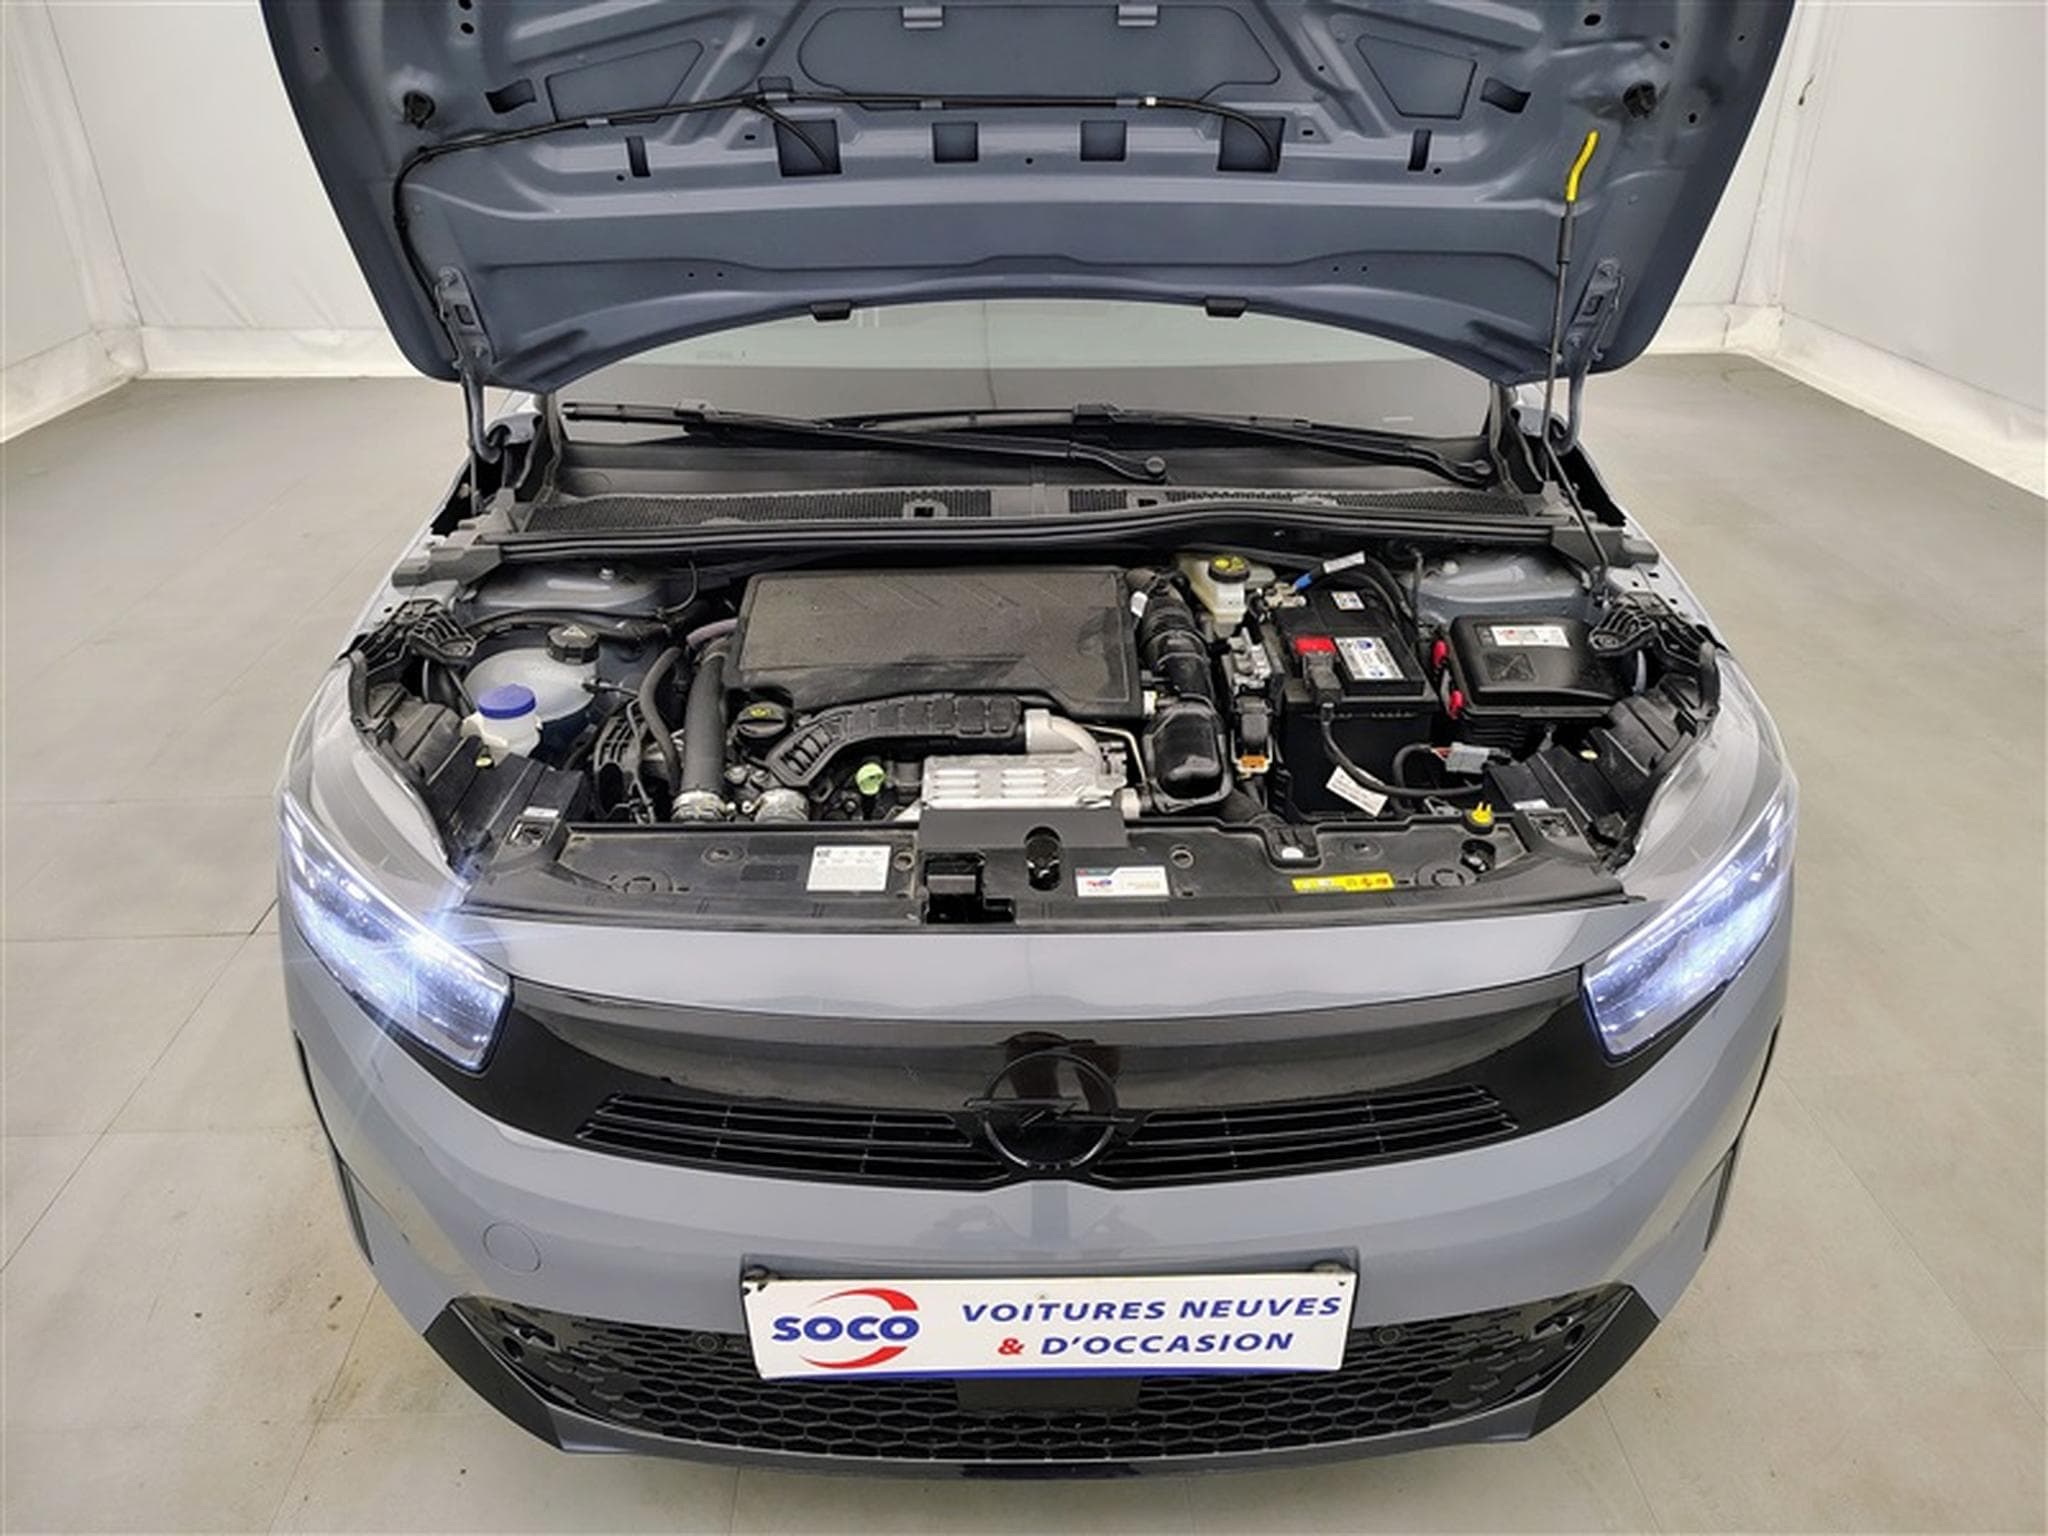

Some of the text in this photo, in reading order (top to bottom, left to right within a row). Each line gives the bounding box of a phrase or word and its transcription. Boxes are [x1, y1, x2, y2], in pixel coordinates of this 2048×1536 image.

[962, 1297, 1342, 1322] VOITURES NEUVES
[772, 1315, 920, 1342] SOCO
[997, 1332, 1293, 1356] & D'OCCASION
